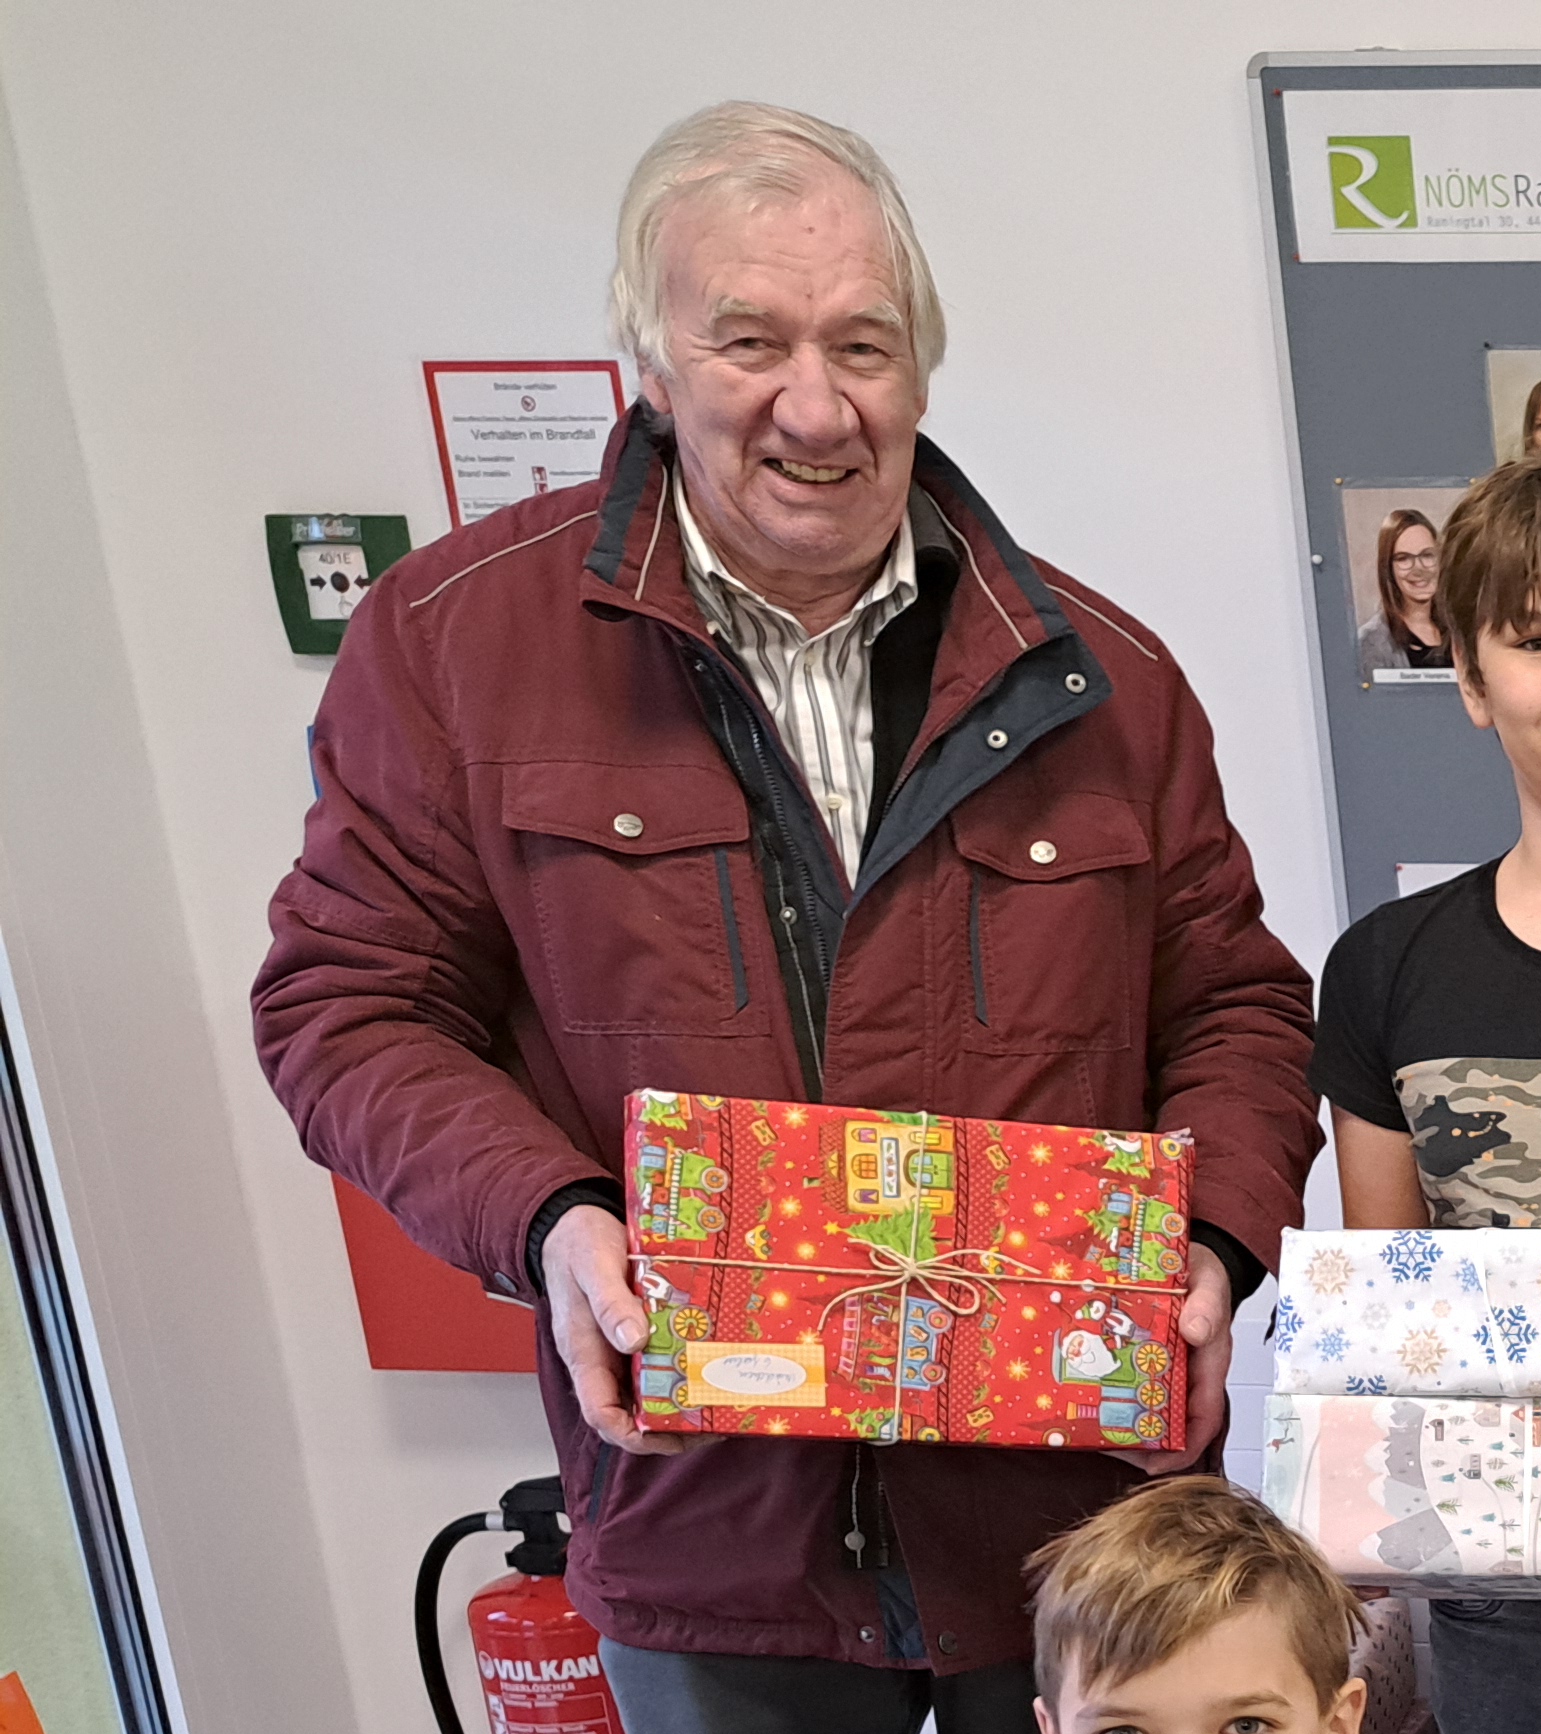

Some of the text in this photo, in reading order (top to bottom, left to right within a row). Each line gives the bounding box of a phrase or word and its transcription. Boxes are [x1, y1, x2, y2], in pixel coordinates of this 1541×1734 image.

[471, 429, 596, 440] Verhalten im Brandfall
[494, 1654, 600, 1682] VULKAN
